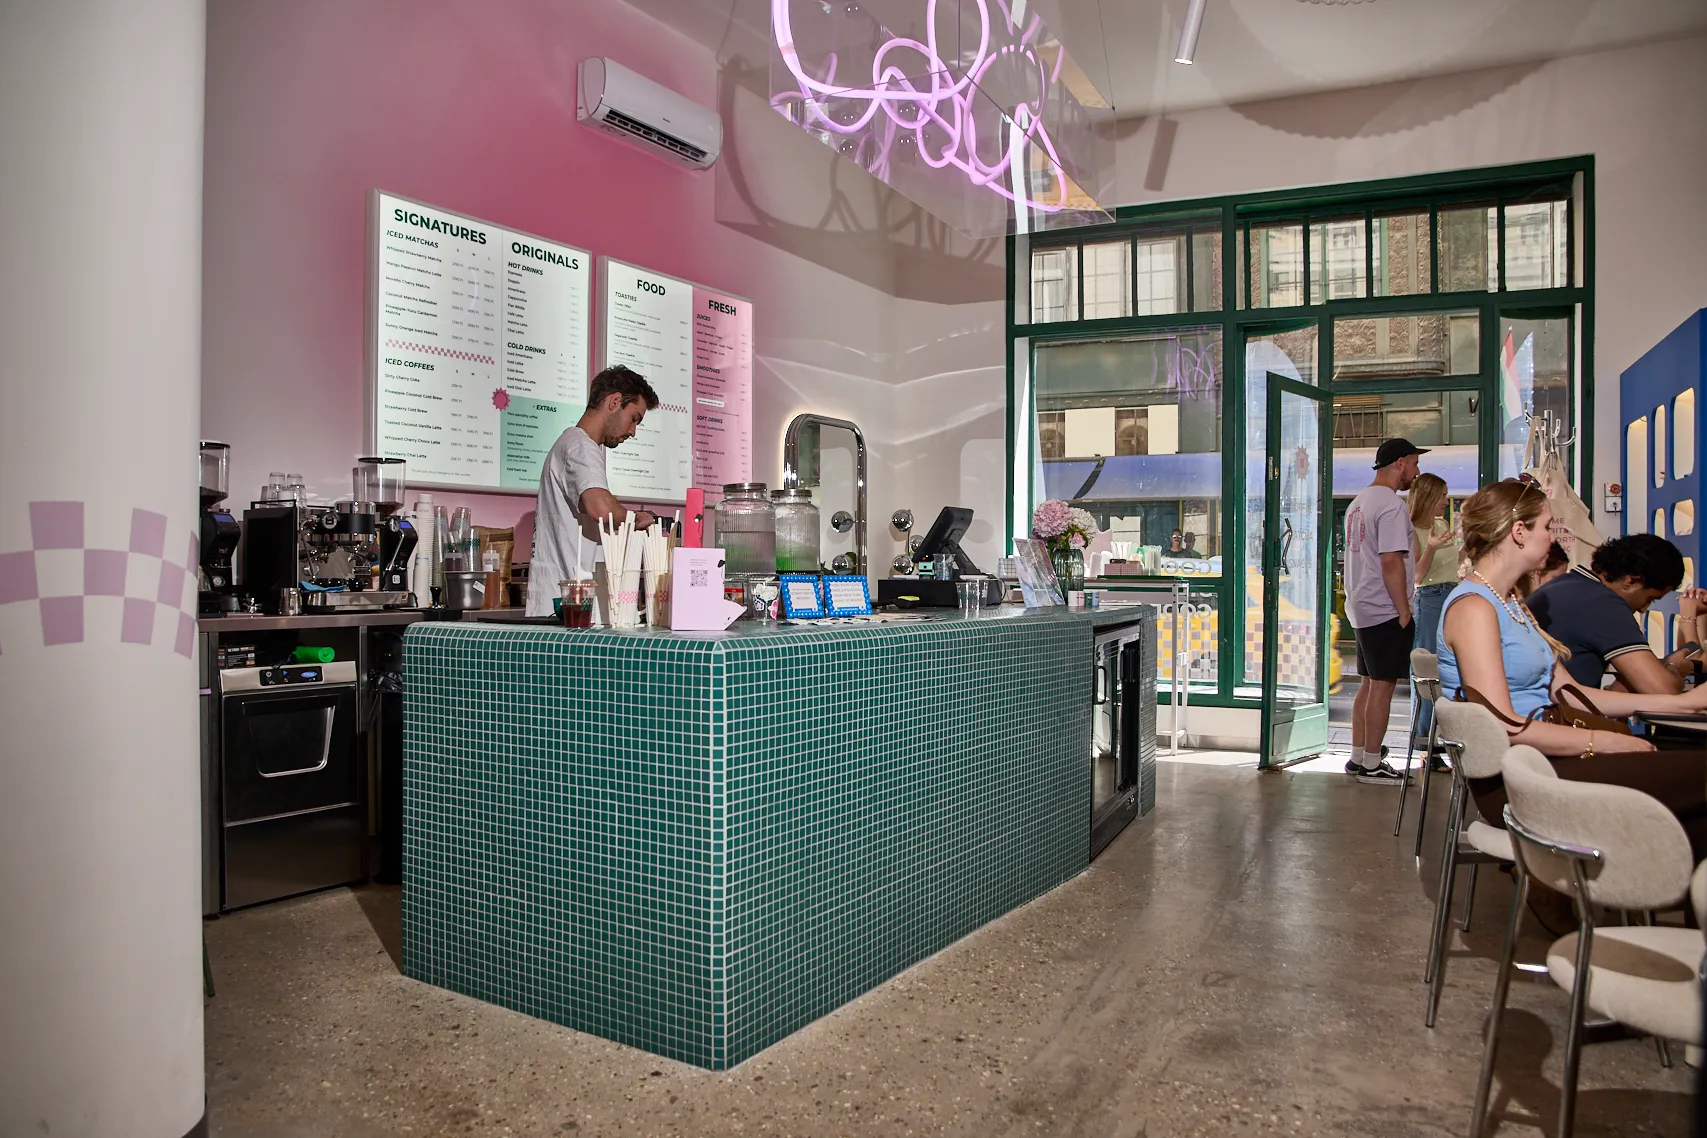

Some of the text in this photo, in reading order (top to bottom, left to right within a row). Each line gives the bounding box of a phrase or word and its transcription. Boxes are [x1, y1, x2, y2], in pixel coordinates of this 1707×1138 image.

[394, 209, 487, 245] SIGNATURES
[387, 230, 438, 248] ICED MATCHAS
[512, 242, 579, 270] ORIGINALS
[508, 262, 543, 275] HOT DRINKS
[637, 279, 666, 296] FOOD
[615, 292, 637, 302] TOASTIES
[708, 300, 736, 316] FRESH
[507, 342, 546, 354] COLD DRINKS
[385, 358, 435, 371] ICED COFFEES
[696, 365, 720, 374] SMOOTHIES
